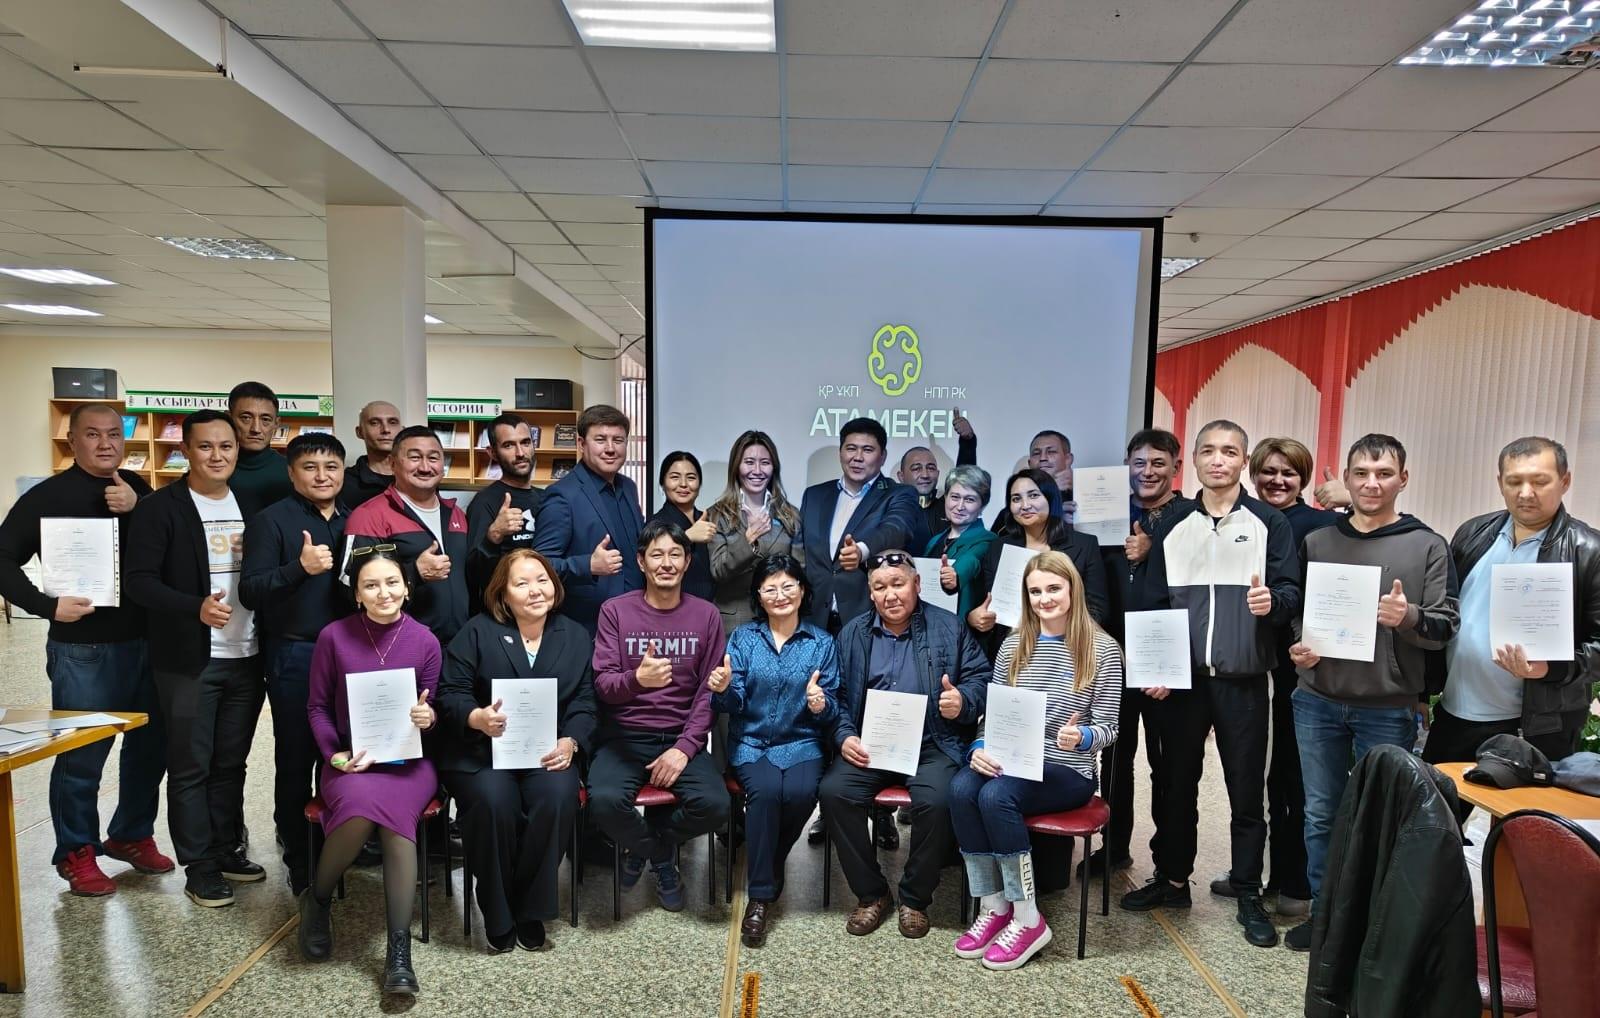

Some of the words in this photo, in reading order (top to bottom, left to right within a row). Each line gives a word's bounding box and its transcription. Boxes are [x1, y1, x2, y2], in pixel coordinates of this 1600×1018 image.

[924, 386, 949, 399] НПП
[951, 387, 966, 399] РК
[625, 637, 699, 656] TERMIT
